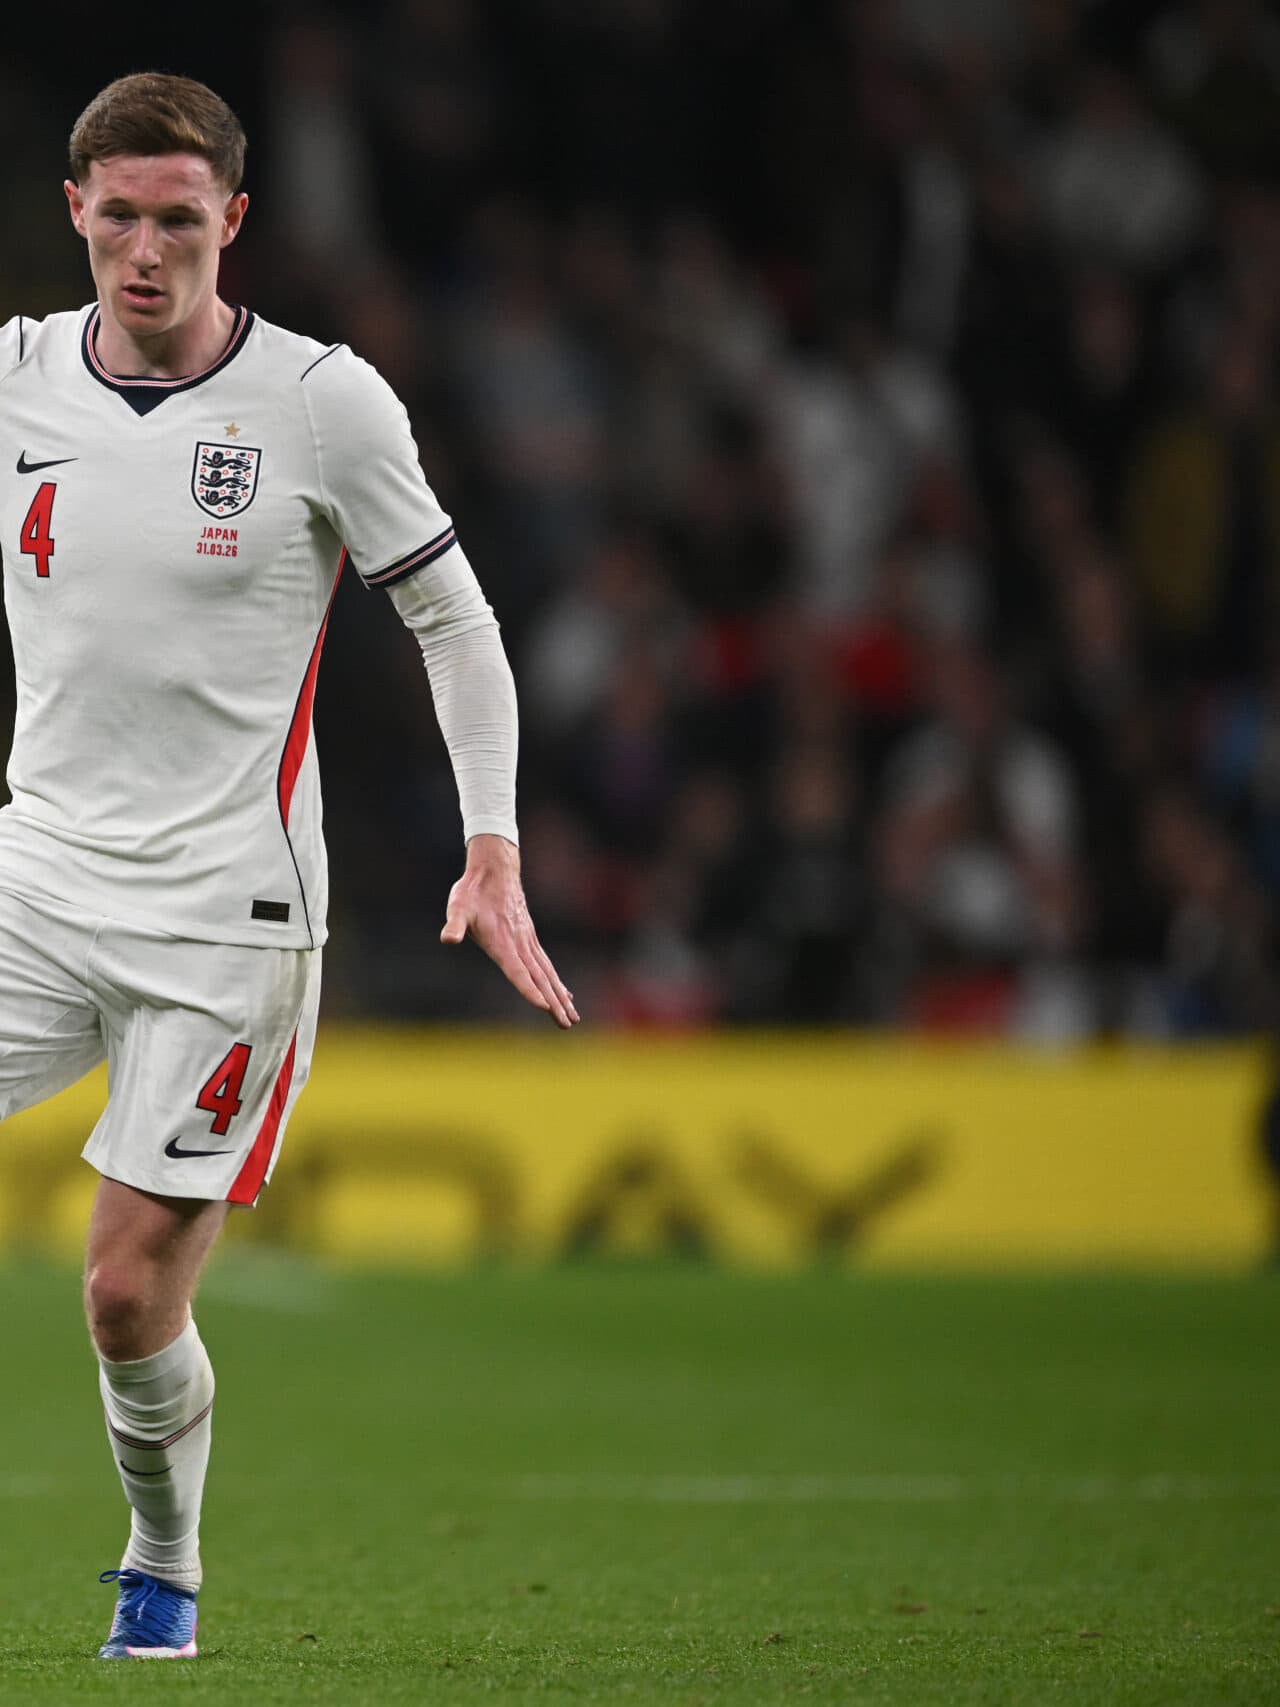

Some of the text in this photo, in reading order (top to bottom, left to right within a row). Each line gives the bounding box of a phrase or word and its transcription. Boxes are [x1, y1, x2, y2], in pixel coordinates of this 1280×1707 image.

[20, 482, 57, 577] 4
[196, 542, 238, 557] 31.03.26
[200, 527, 238, 541] JAPAN
[195, 1042, 252, 1136] 4
